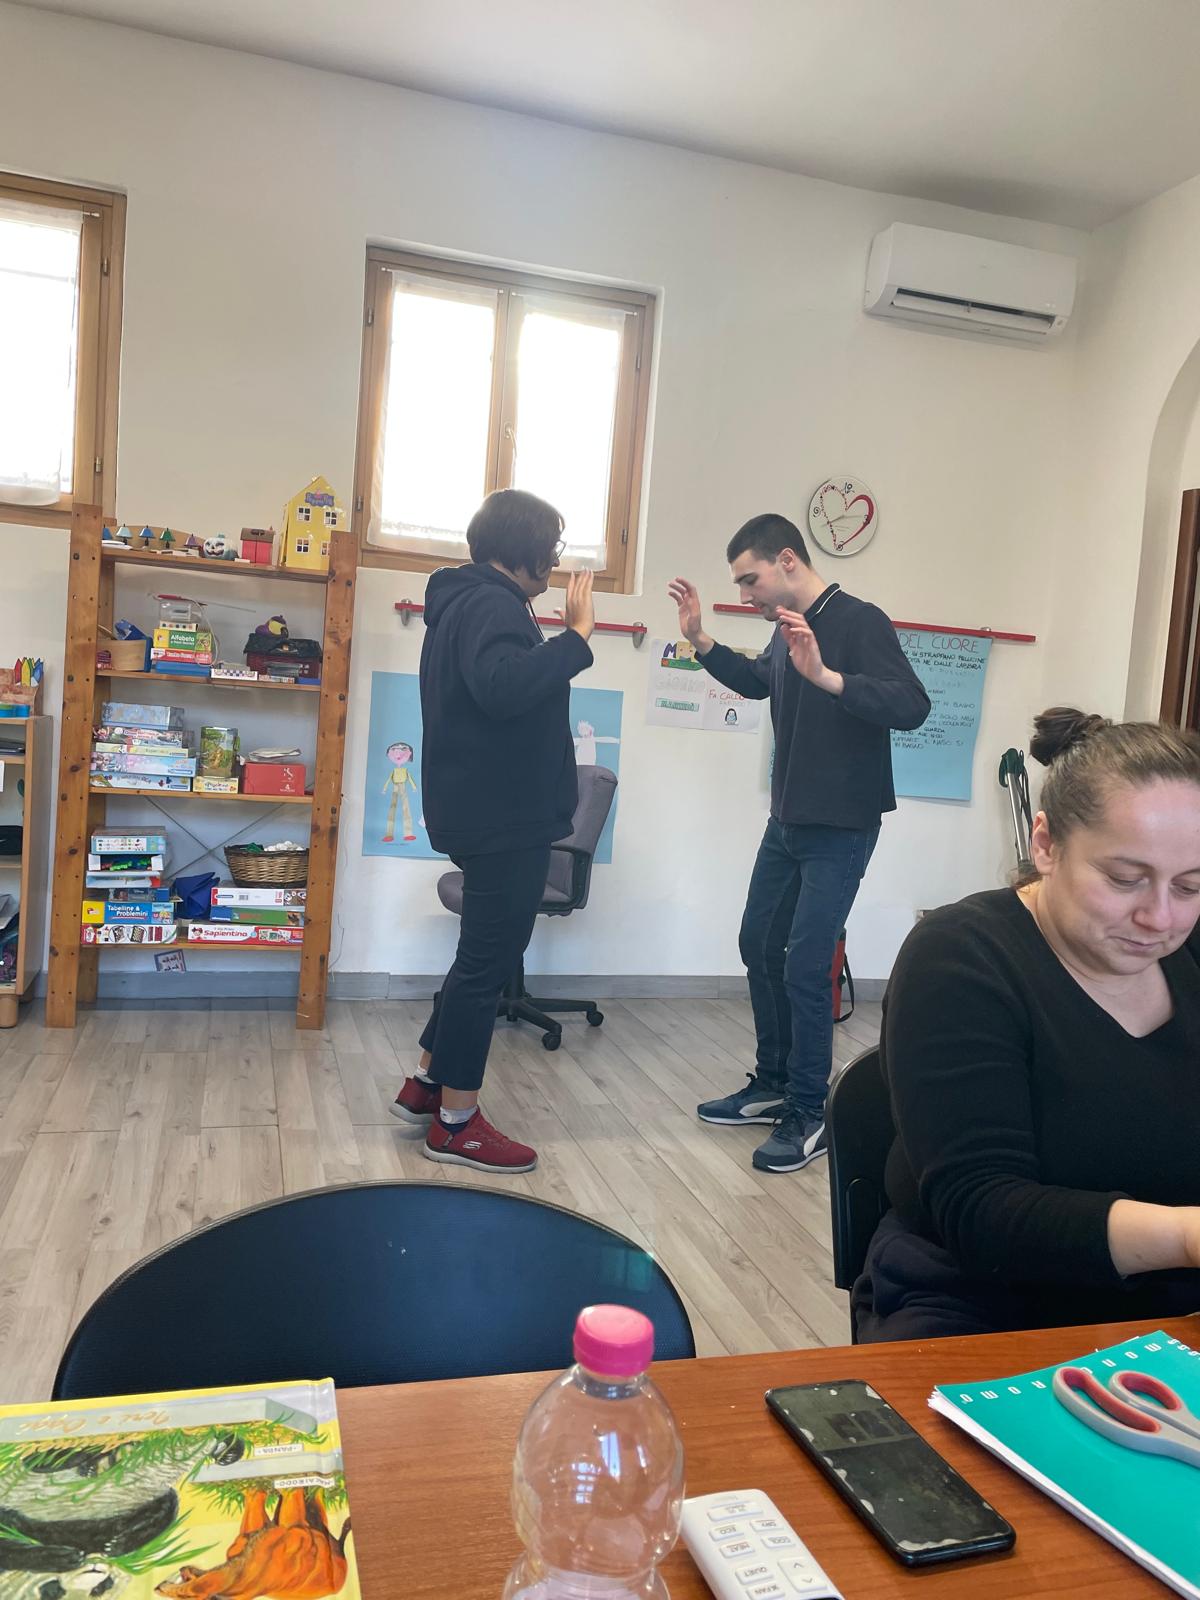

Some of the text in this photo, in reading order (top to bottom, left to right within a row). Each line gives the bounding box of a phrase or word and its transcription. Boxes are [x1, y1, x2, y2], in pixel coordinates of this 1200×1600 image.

[170, 634, 195, 642] Alfabeto
[116, 910, 148, 918] Problemini
[203, 930, 248, 938] Sapientino
